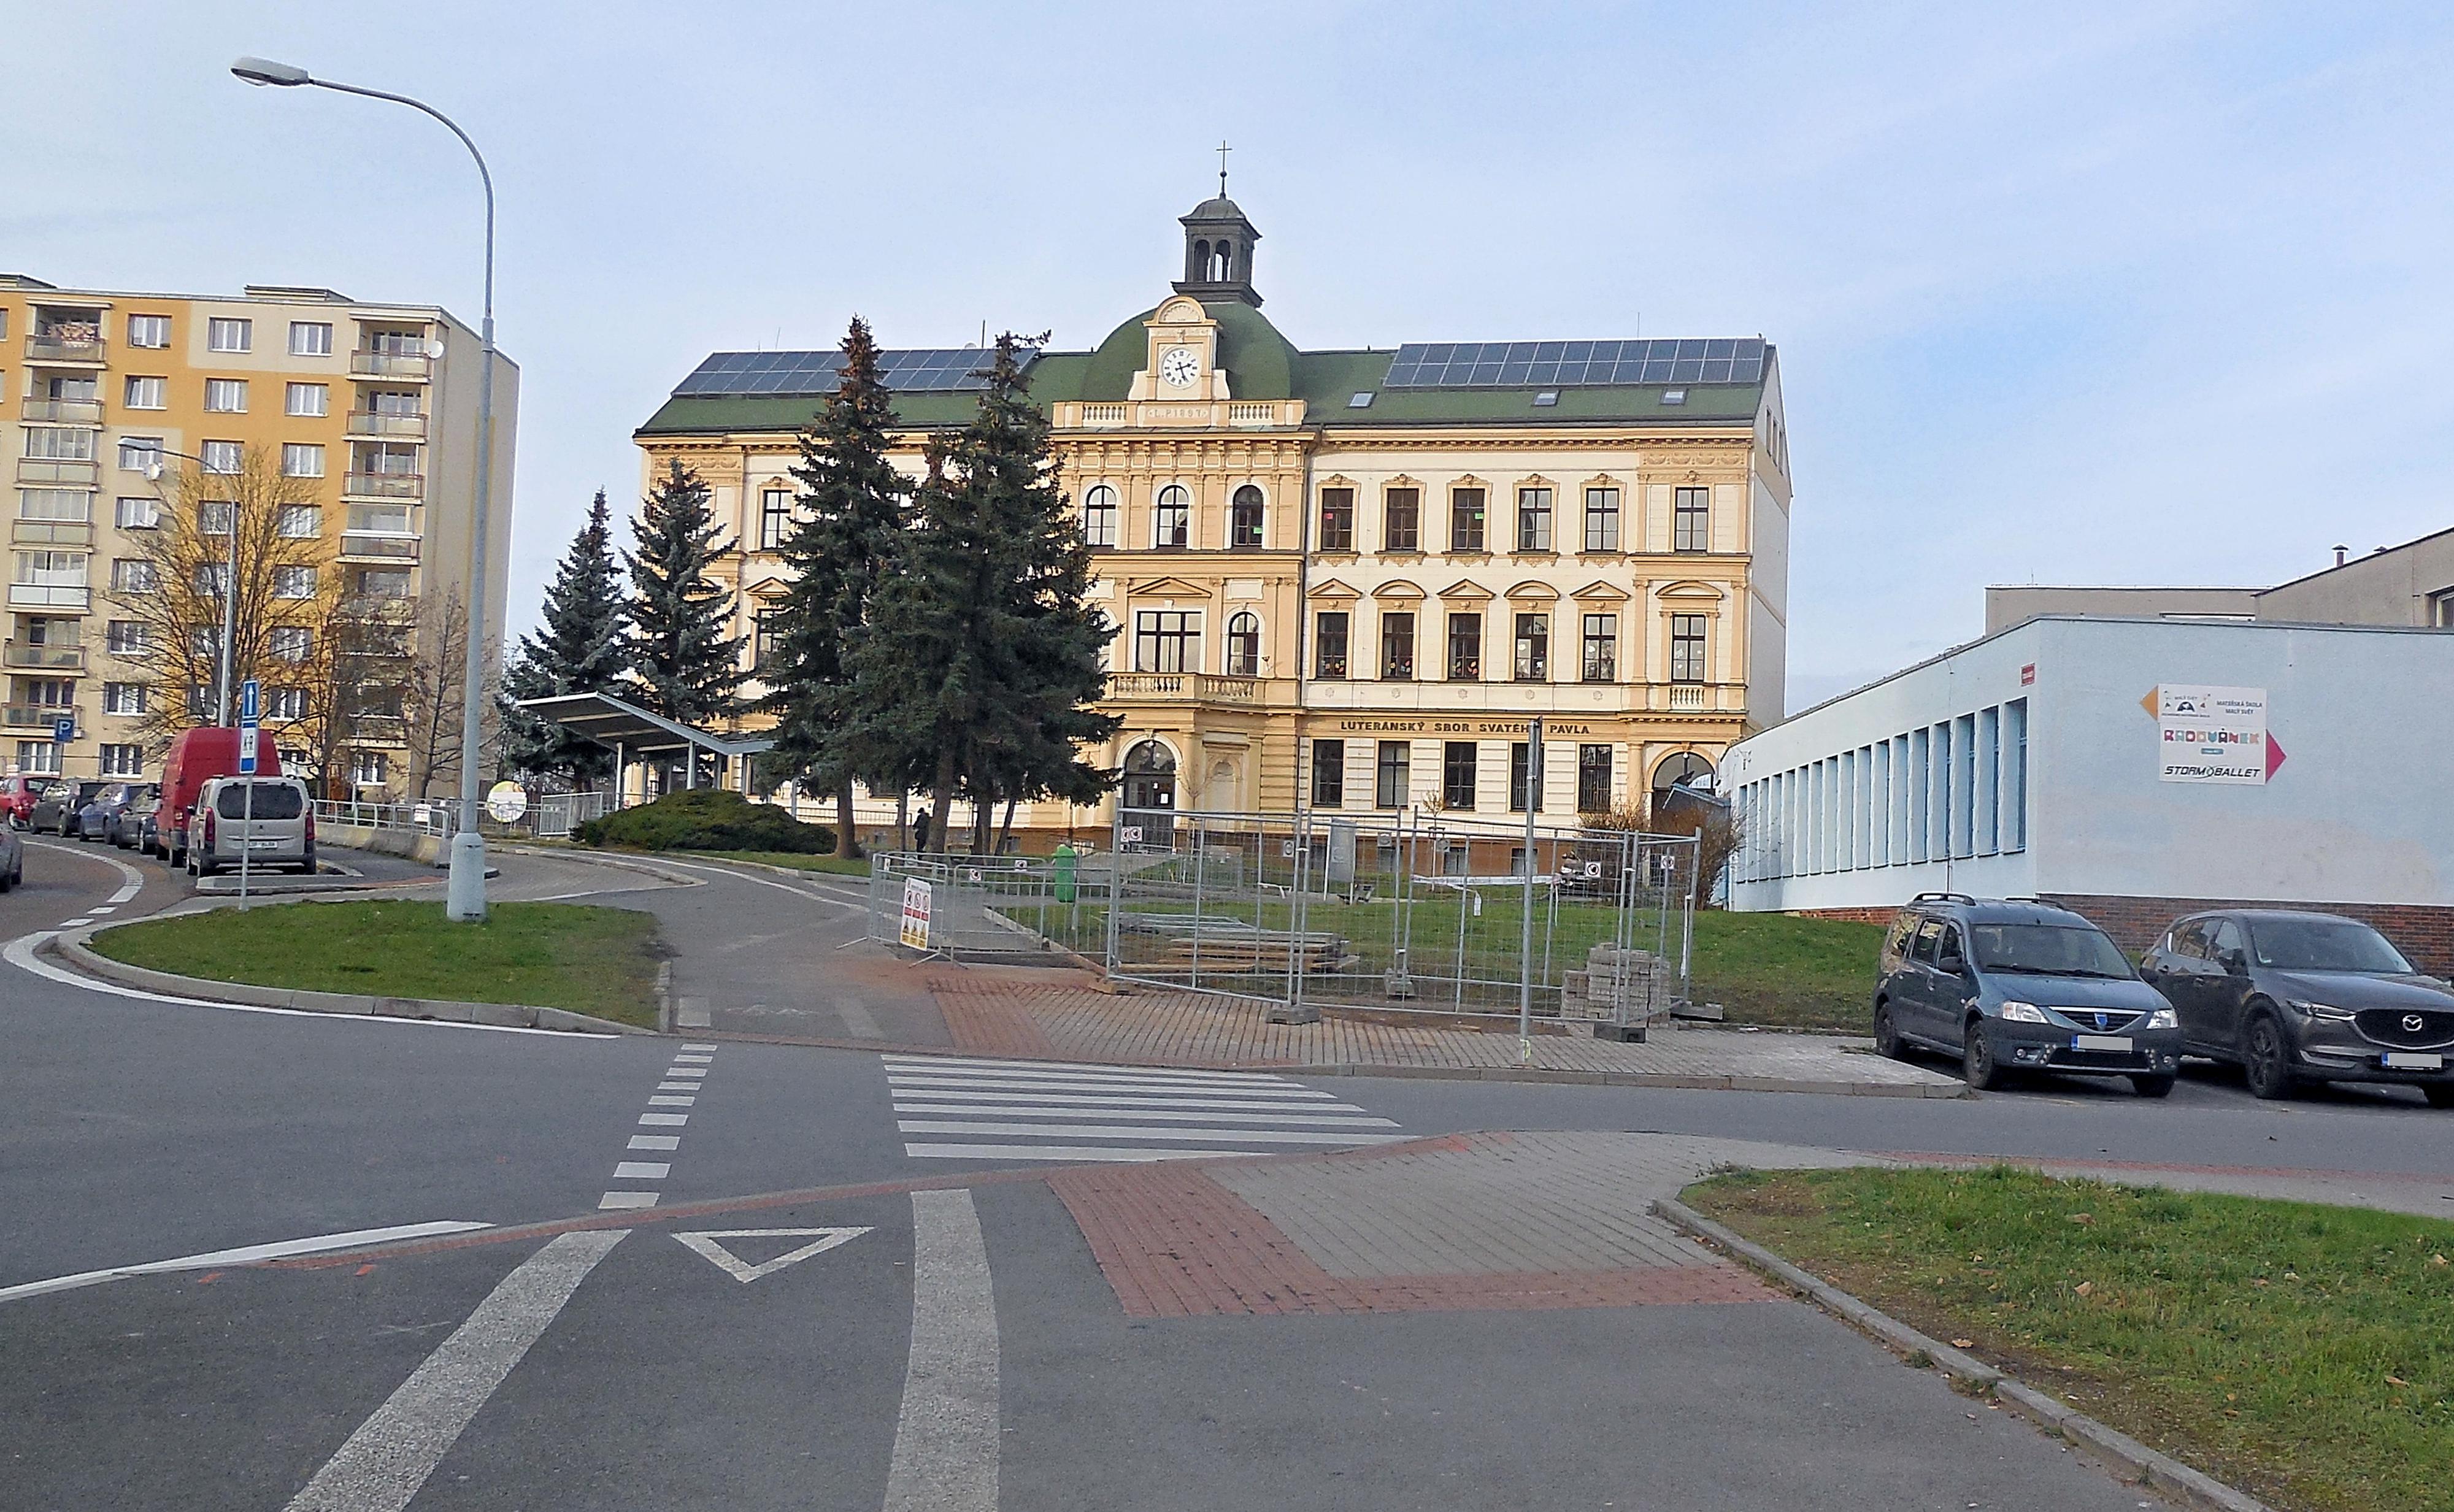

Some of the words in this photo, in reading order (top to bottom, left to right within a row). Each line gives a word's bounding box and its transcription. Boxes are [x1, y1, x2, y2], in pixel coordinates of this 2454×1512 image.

[59, 721, 71, 735] P
[1340, 721, 1425, 731] LUTERÁNSKÝ
[1434, 723, 1470, 732] SBOR
[1479, 723, 1530, 733] SVATÉH
[1549, 724, 1590, 734] PAVLA
[2164, 727, 2260, 745] RADOVÁNEK
